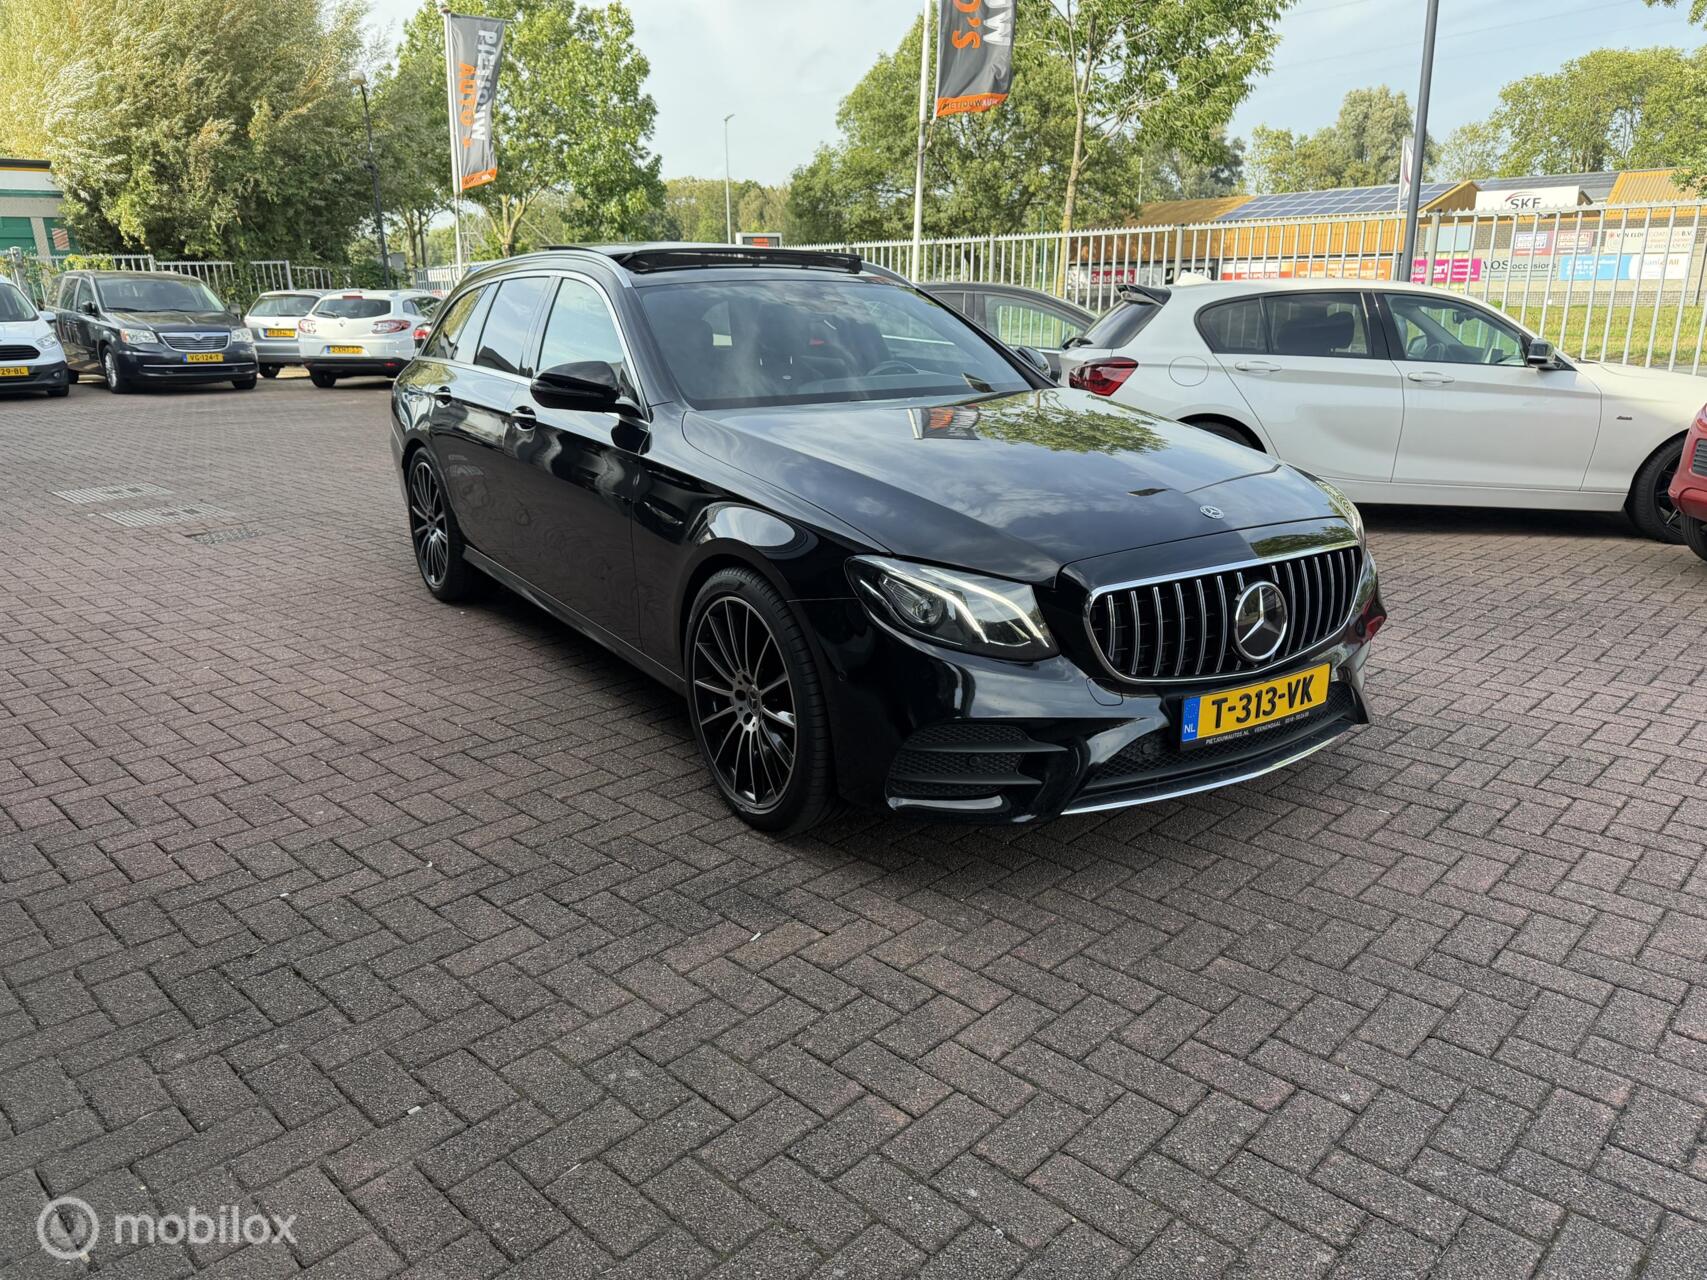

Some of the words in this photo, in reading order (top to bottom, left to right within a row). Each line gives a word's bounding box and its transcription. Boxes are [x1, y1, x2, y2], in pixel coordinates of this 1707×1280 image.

[1510, 197, 1542, 210] SKF
[1184, 724, 1196, 735] NL
[1212, 674, 1315, 729] T-313-VK
